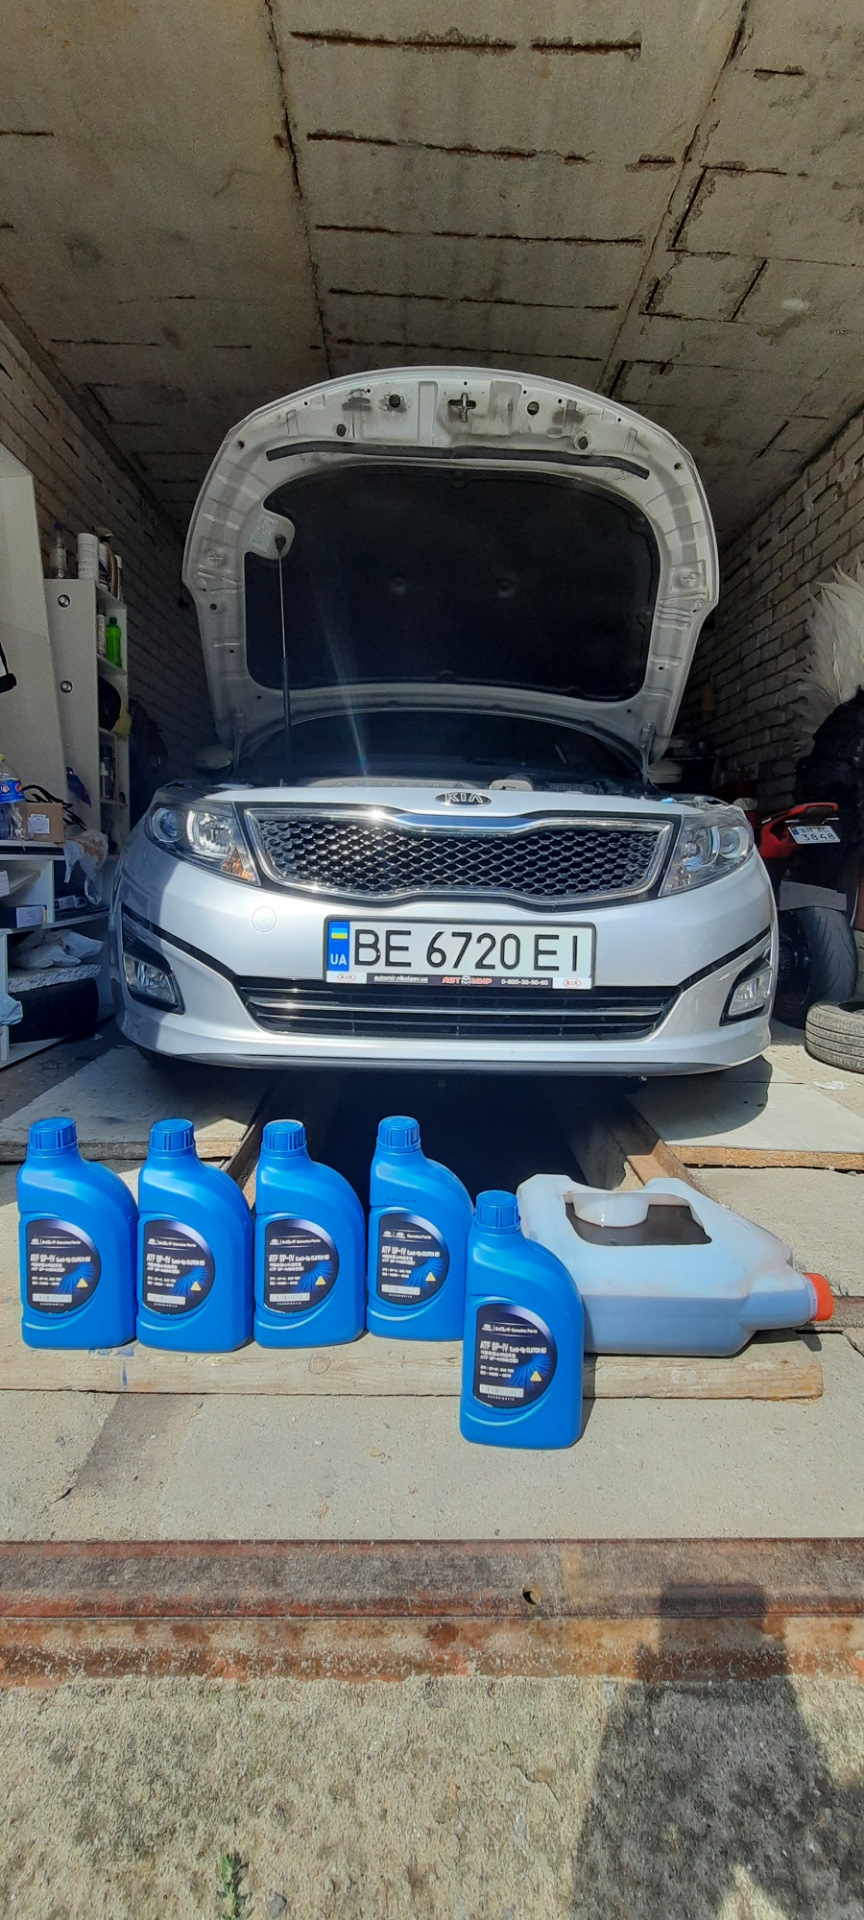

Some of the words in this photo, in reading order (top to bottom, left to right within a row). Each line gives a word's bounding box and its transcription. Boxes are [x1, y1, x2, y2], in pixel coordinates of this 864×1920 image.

[444, 792, 484, 804] KIA
[801, 833, 836, 841] 3848
[354, 929, 412, 968] BE
[426, 931, 521, 971] 6720
[533, 934, 579, 972] EI
[330, 953, 348, 966] UA
[480, 1340, 491, 1350] ATF
